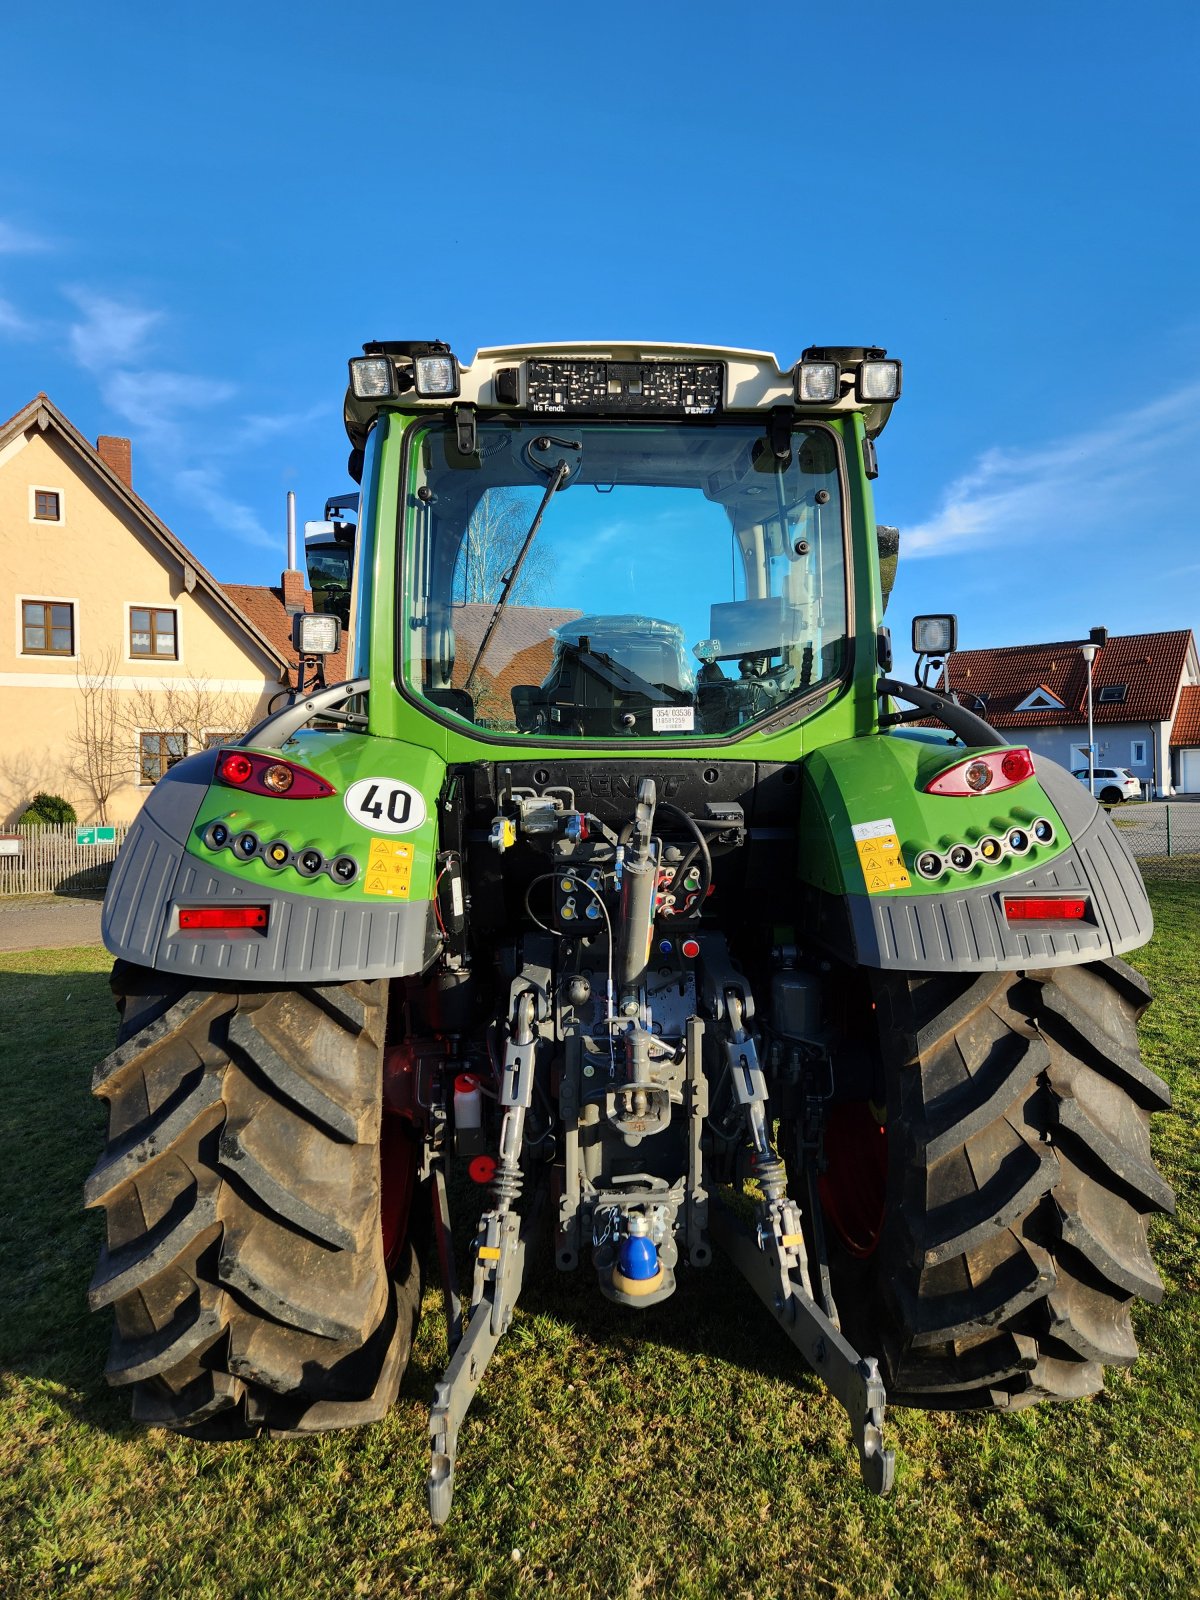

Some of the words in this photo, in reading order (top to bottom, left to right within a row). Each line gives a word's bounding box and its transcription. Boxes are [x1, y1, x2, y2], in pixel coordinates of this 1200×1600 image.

[533, 404, 543, 412] It's
[544, 404, 566, 413] Fendt.
[684, 406, 716, 414] FENDT
[360, 784, 412, 824] 40
